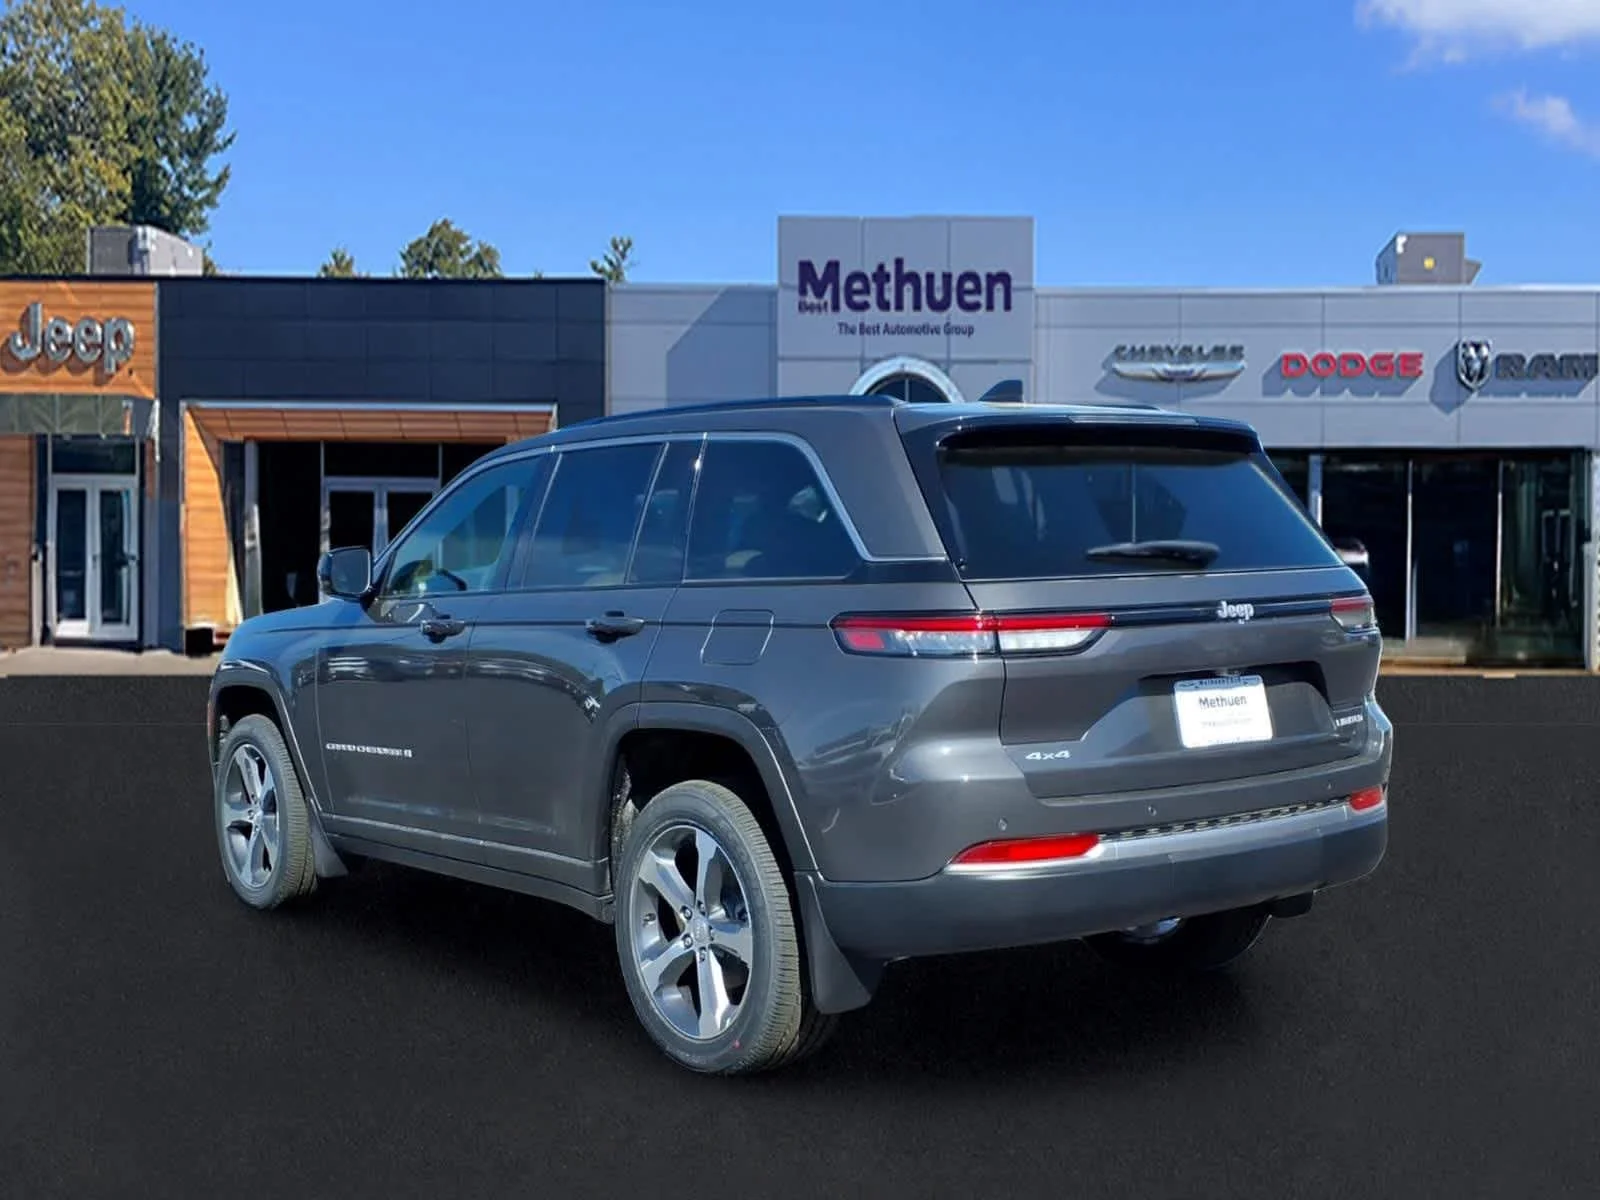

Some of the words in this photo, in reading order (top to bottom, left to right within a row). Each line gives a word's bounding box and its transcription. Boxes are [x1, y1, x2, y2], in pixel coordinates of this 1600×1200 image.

[798, 257, 1012, 313] Methuen
[798, 300, 828, 314] Best
[9, 302, 135, 374] Jeep
[838, 321, 857, 335] The
[859, 321, 881, 336] Best
[883, 321, 941, 336] Automotive
[944, 321, 975, 338] Group
[1281, 352, 1424, 378] DODGE
[1496, 353, 1599, 379] RAM
[1216, 600, 1254, 620] Jeep
[1199, 695, 1248, 709] Methuen
[1025, 750, 1070, 760] 4x4
